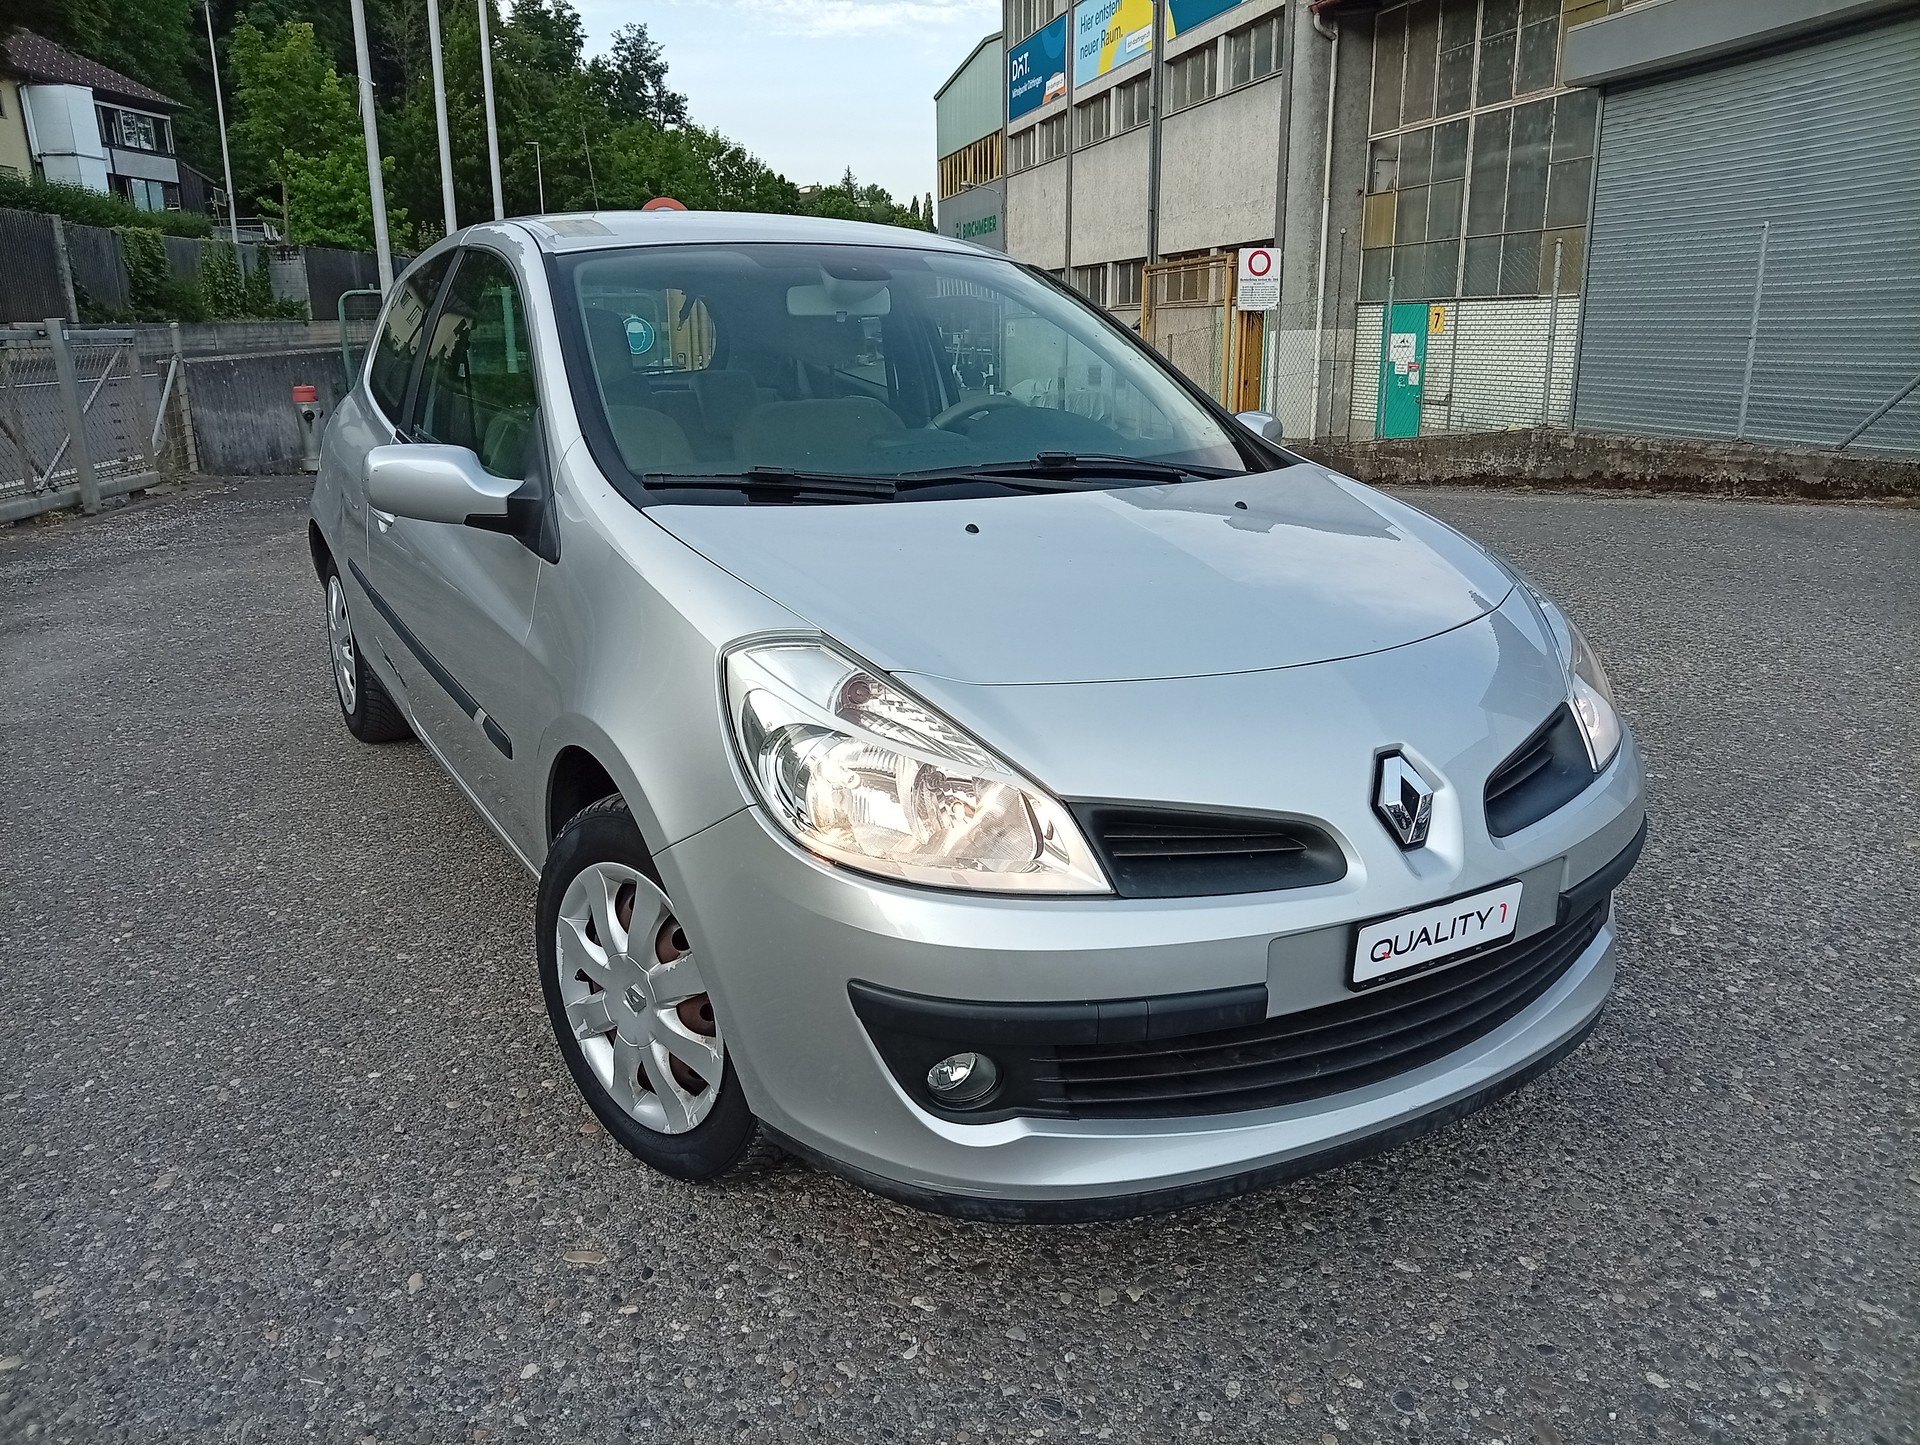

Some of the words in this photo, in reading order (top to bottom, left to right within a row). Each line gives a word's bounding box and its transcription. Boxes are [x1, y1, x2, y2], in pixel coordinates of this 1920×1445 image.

[1080, 14, 1094, 35] Hier
[1080, 37, 1100, 60] neuer
[1101, 25, 1124, 49] Raum.
[963, 215, 997, 240] BIRCHMEIER
[1434, 312, 1441, 329] 7
[1370, 906, 1494, 962] QUALITY
[1499, 903, 1508, 924] 1
